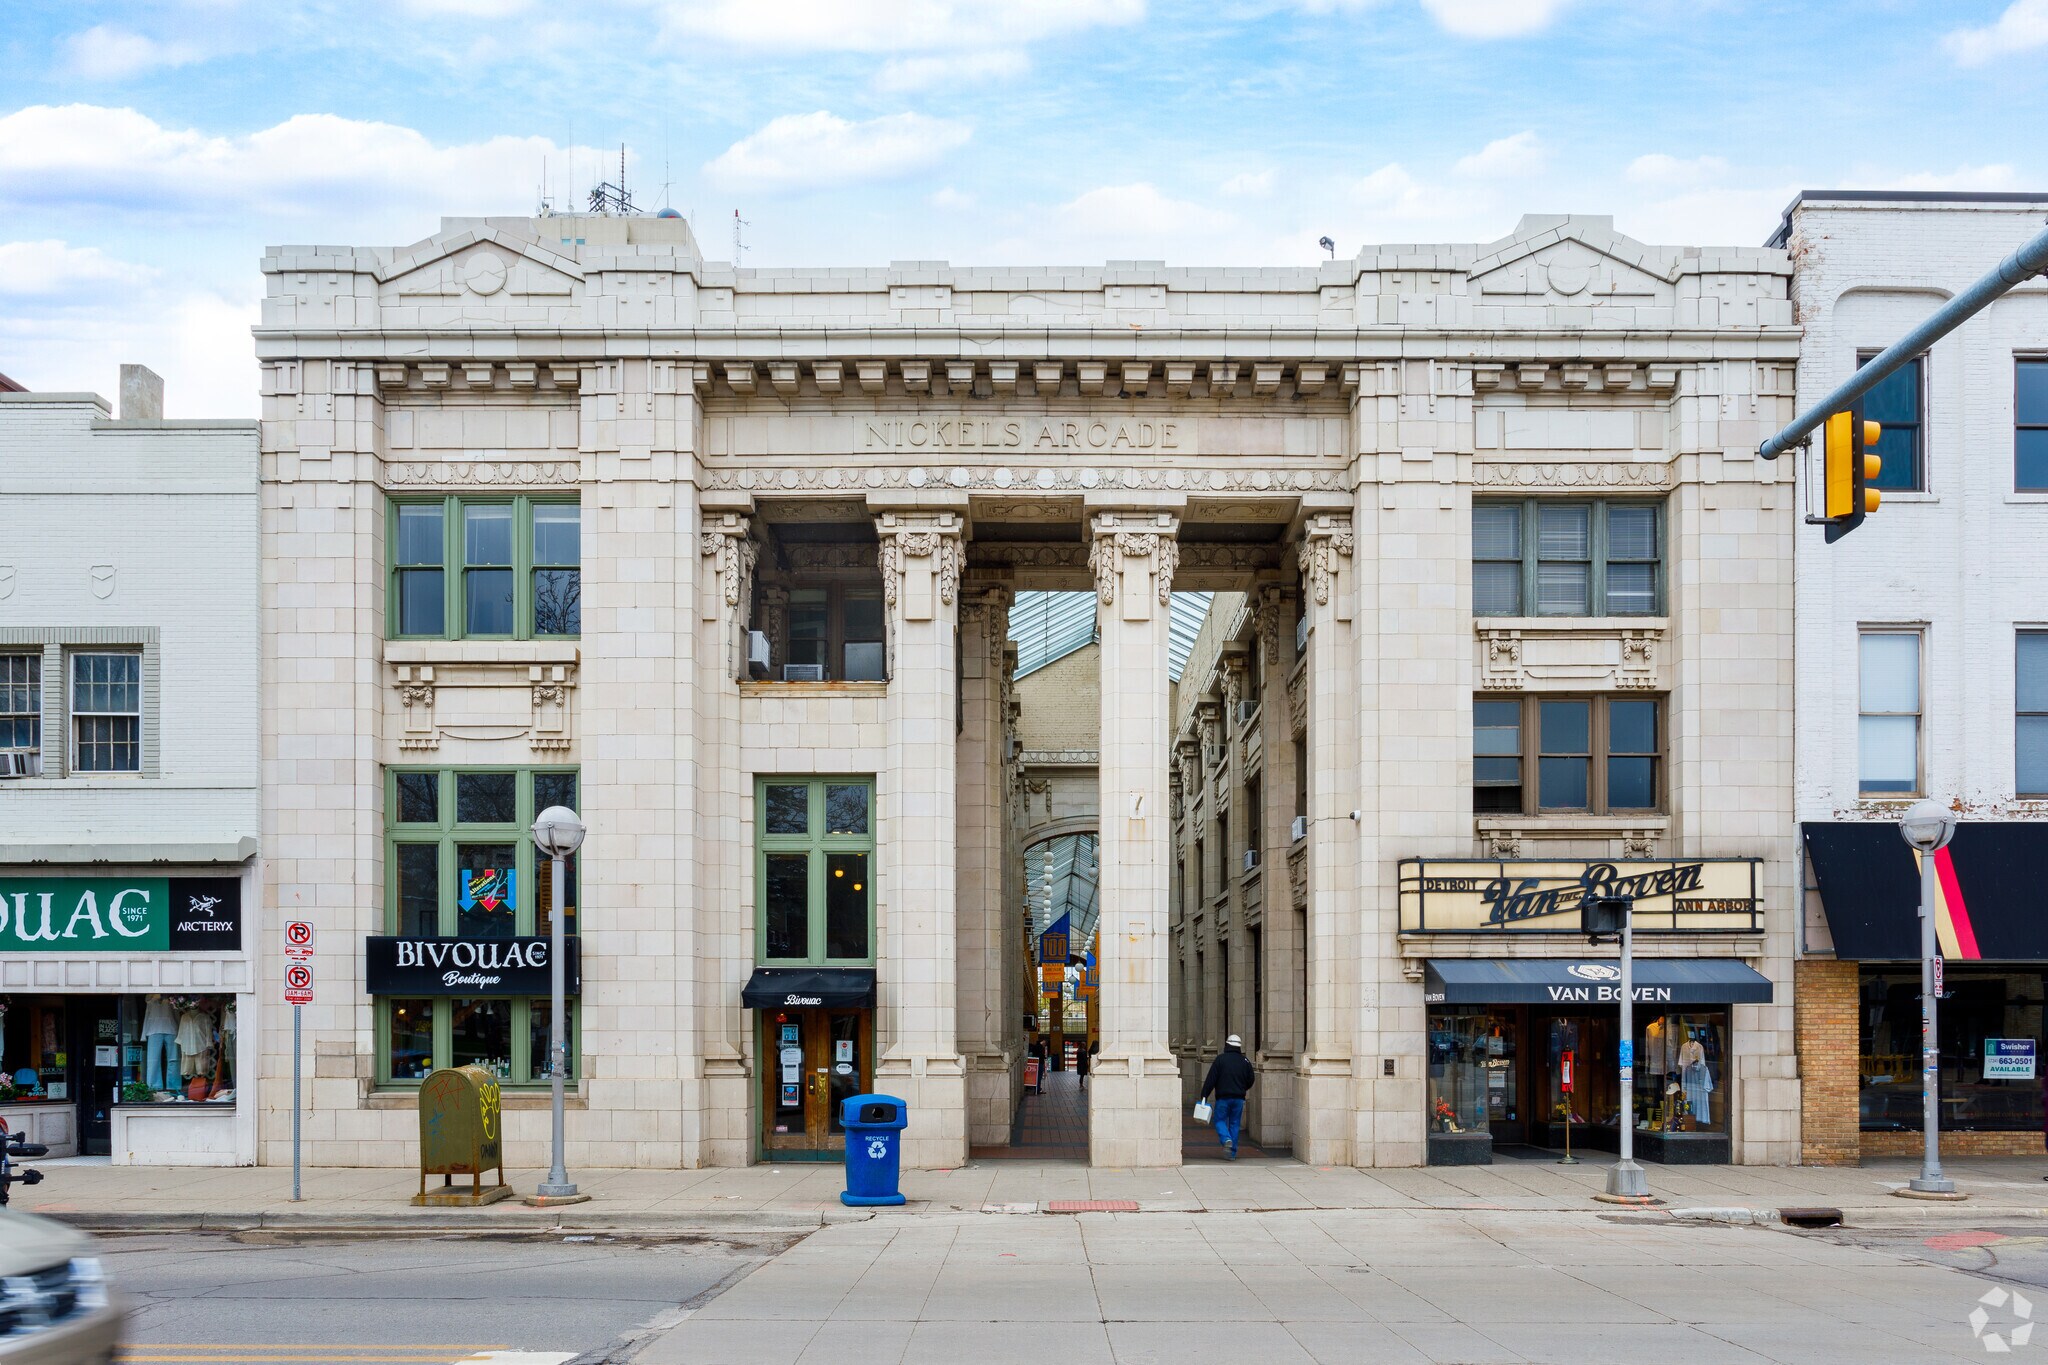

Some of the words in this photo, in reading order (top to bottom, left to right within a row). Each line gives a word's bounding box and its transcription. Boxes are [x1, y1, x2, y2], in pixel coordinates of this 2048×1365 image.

[865, 421, 1022, 447] NICKELS
[1033, 422, 1179, 448] ARCADE
[1425, 879, 1479, 892] DETROIT
[1482, 877, 1560, 923] Van
[1580, 862, 1703, 906] Boven
[122, 907, 147, 915] SINCE
[1676, 900, 1703, 912] ANN
[1707, 900, 1752, 913] ARBOR
[0, 888, 151, 942] UAC
[126, 914, 143, 922] 1971
[396, 941, 547, 969] BIVOUAC
[441, 970, 502, 990] Boutique
[1548, 985, 1592, 1001] VAN
[783, 994, 822, 1006] Bivouac
[2000, 1042, 2030, 1050] Swisher
[1998, 1057, 2033, 1065] 663-0501
